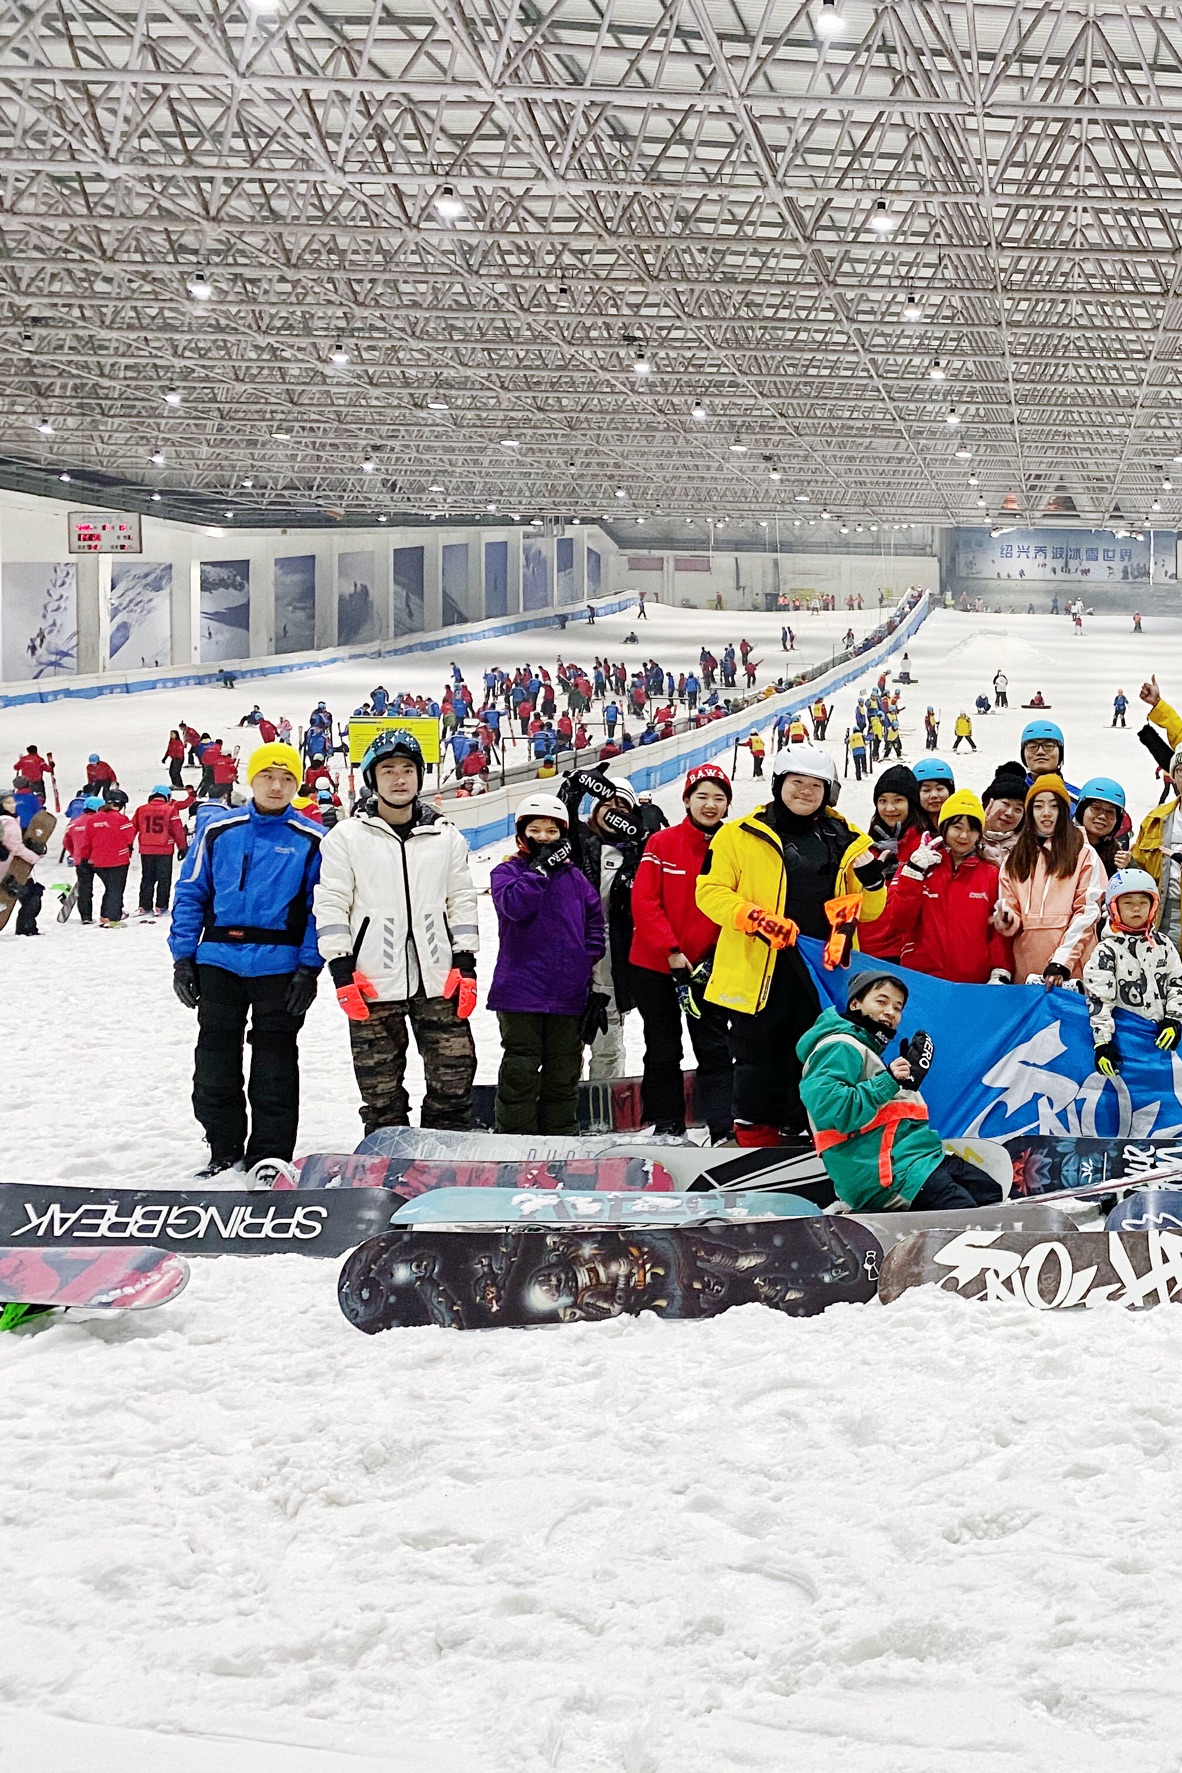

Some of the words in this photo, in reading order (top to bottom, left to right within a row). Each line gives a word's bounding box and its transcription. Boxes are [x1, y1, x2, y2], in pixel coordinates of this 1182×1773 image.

[1000, 544, 1133, 562] 绍兴乔波冰雪世界
[578, 774, 615, 799] SNOW
[144, 815, 165, 834] 15
[604, 811, 638, 836] HERO
[10, 1203, 328, 1239] SPRINGBREAK
